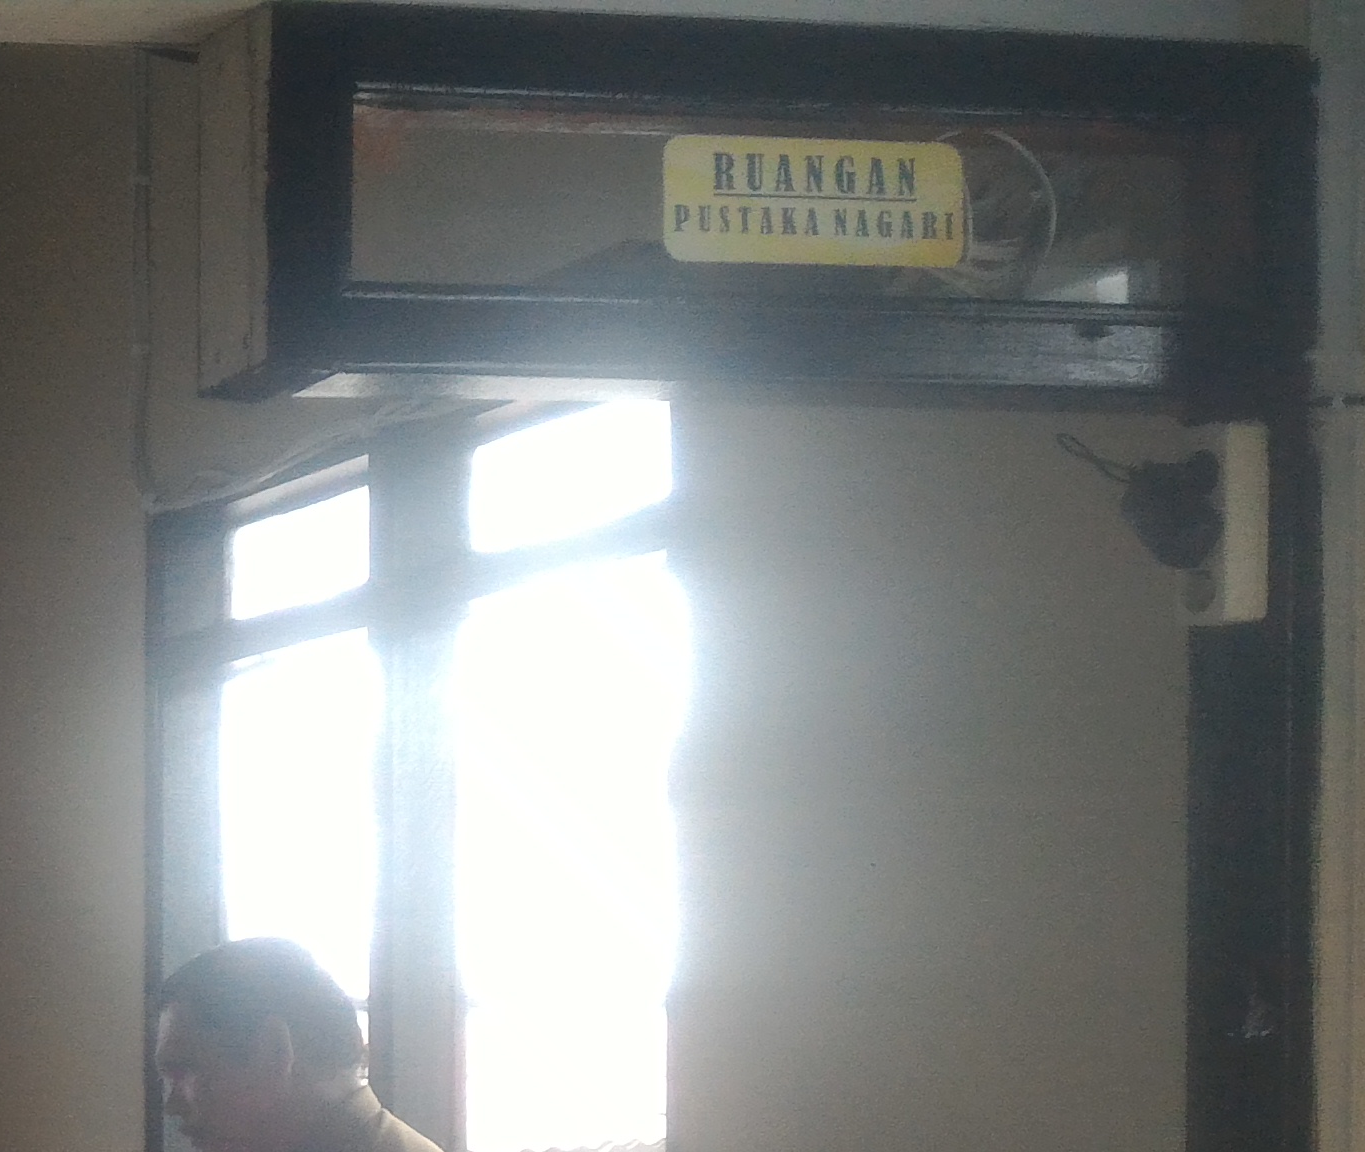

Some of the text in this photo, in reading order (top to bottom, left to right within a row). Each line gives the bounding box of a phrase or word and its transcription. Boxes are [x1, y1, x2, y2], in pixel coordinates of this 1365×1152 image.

[713, 151, 917, 197] RUANGAN
[673, 204, 955, 241] PUSTAKA NAGARI
